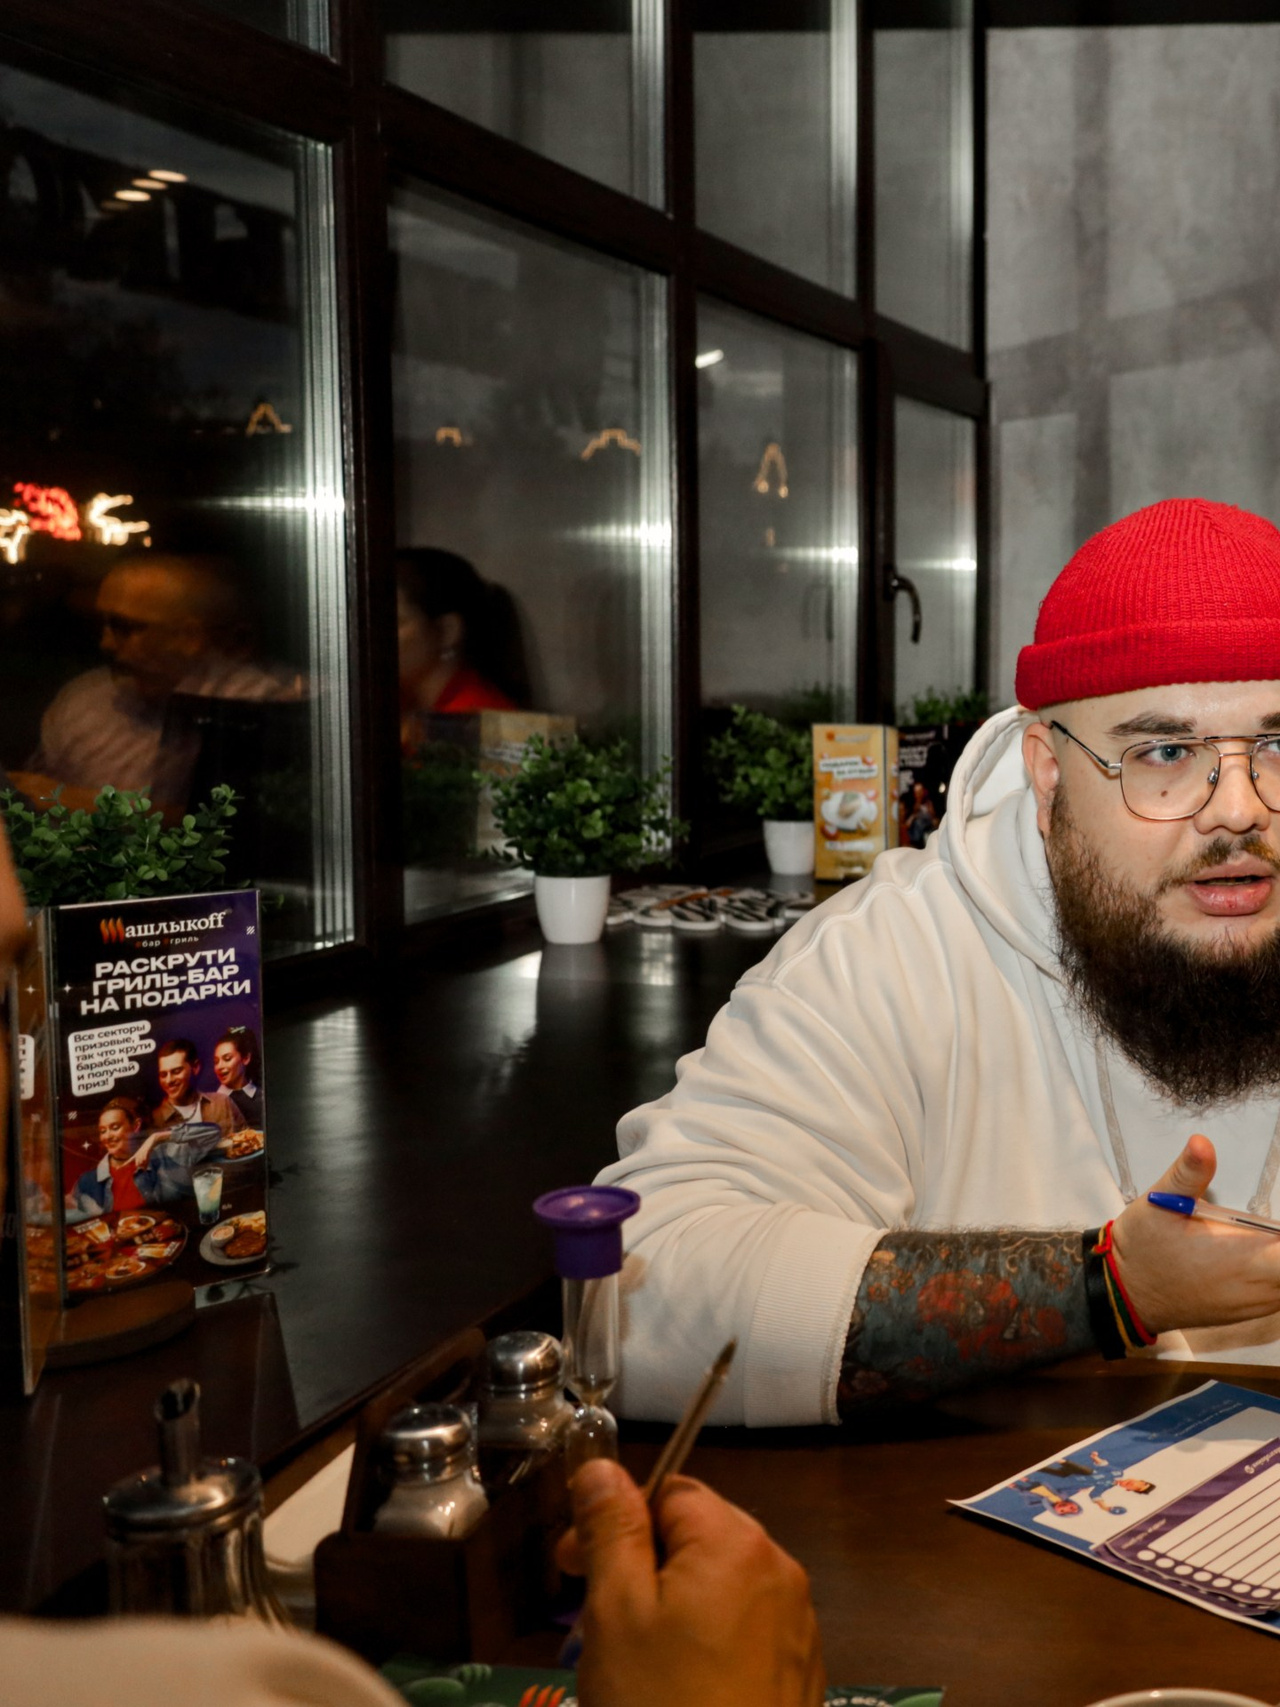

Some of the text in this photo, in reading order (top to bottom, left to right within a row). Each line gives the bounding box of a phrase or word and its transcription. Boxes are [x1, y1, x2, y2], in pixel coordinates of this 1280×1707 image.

[142, 936, 199, 948] бар гриль
[95, 947, 236, 979] РАСКРУТИ
[92, 964, 240, 996] ГРИЛЬ-БАР
[80, 979, 252, 1016] НА ПОДАРКИ
[73, 1024, 146, 1043] Все секторы
[74, 1036, 135, 1053] призовые,
[75, 1042, 152, 1062] так что крути
[76, 1057, 124, 1072] барабан
[87, 1062, 136, 1079] получай
[77, 1077, 109, 1092] приз!
